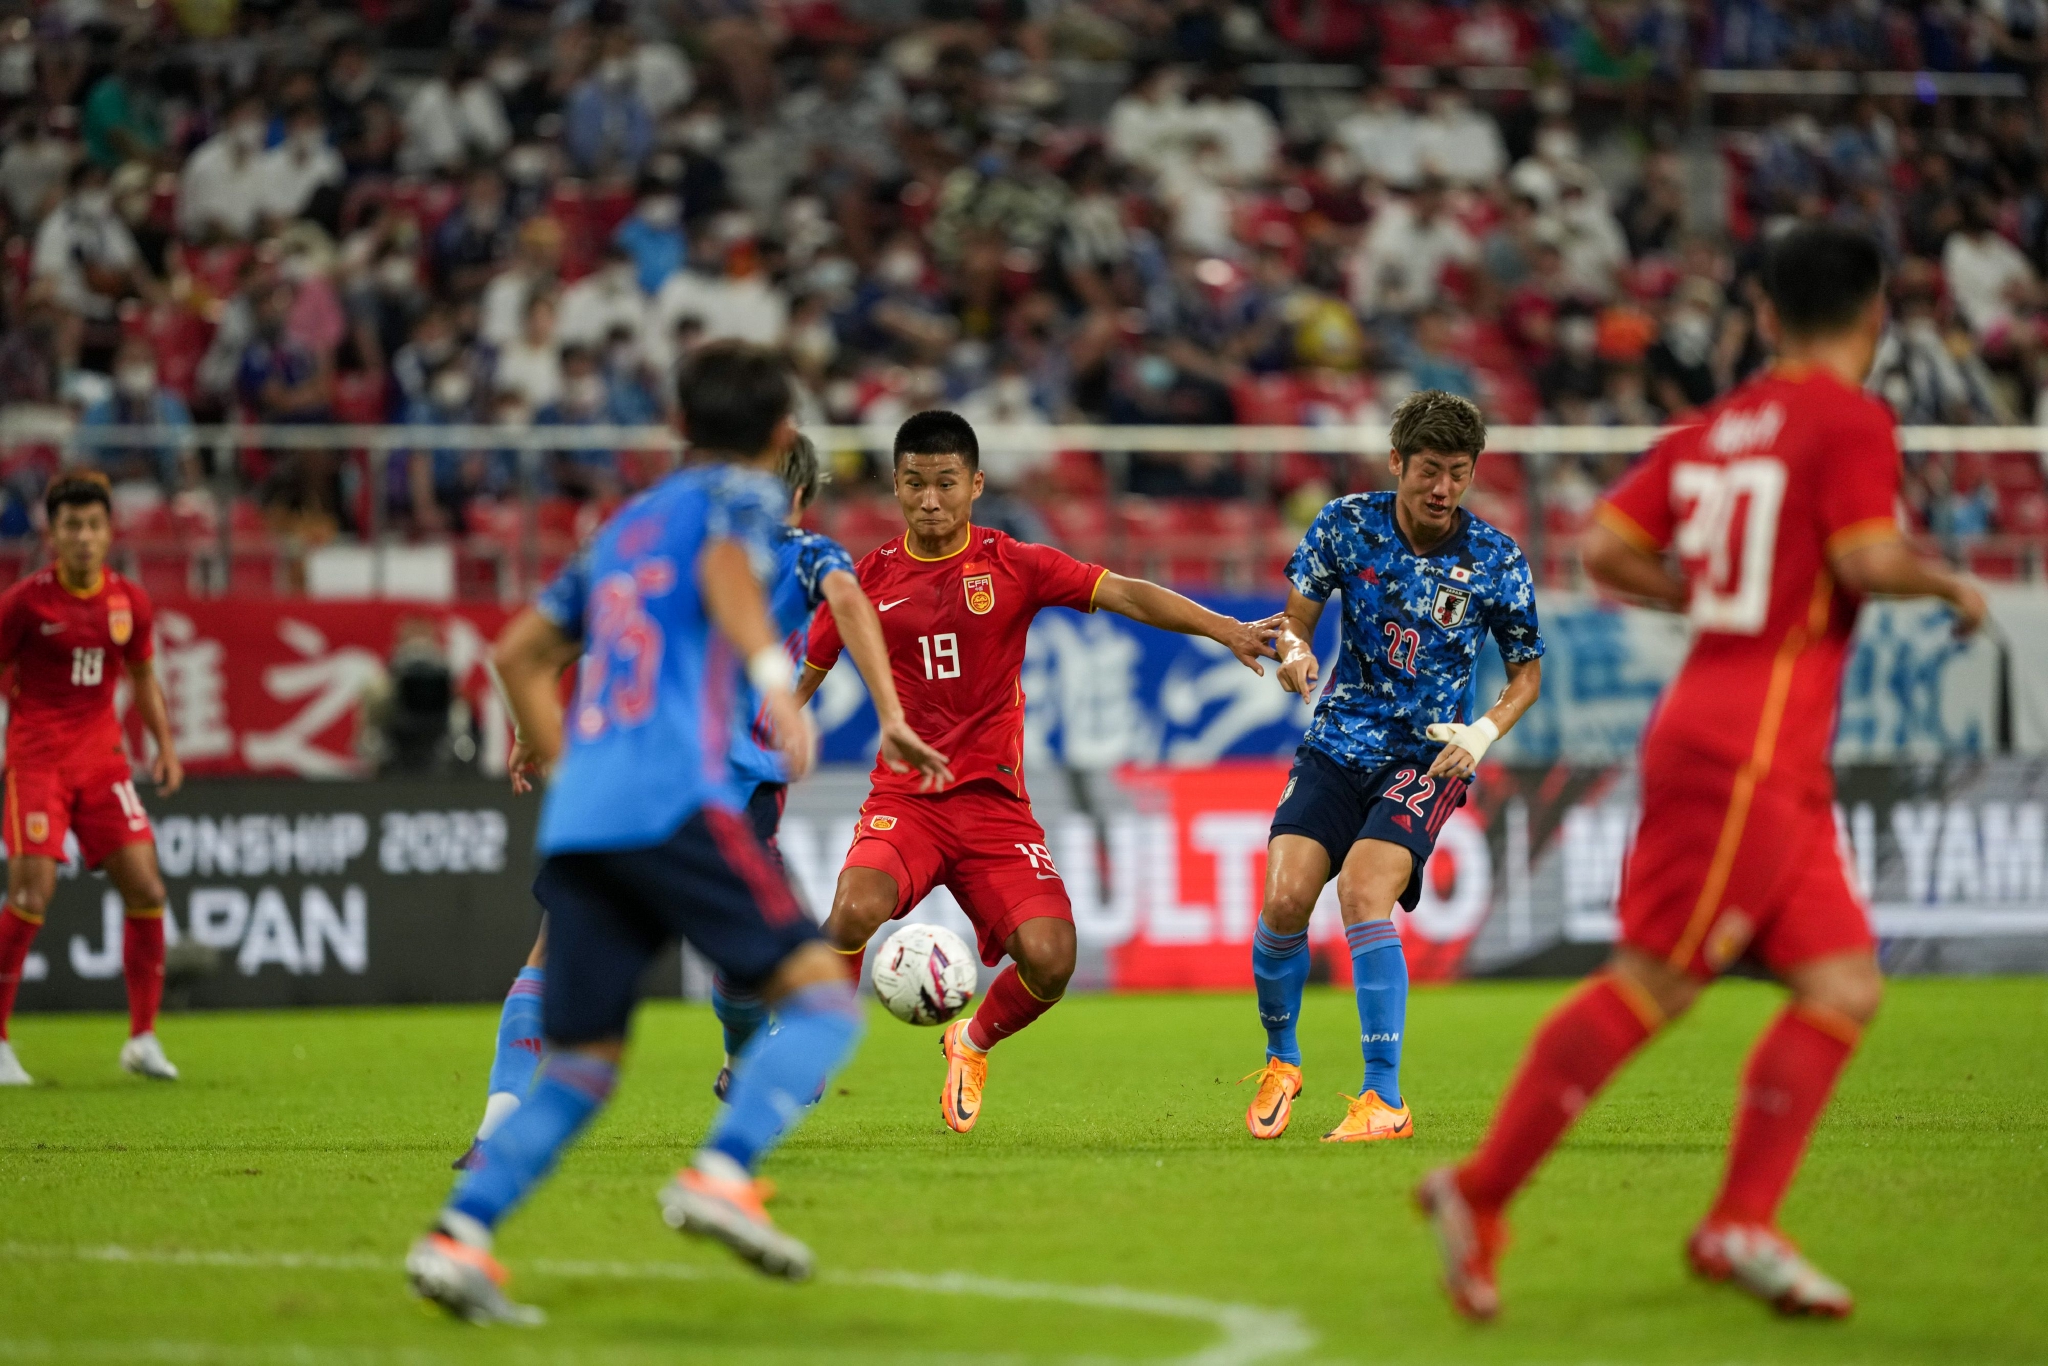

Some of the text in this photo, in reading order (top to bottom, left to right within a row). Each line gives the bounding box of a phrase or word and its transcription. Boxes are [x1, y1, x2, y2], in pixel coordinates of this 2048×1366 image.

[918, 632, 961, 680] 19
[1384, 621, 1421, 677] 22
[1383, 768, 1436, 818] 22
[379, 809, 507, 874] 2022
[1057, 808, 1494, 948] ULTO
